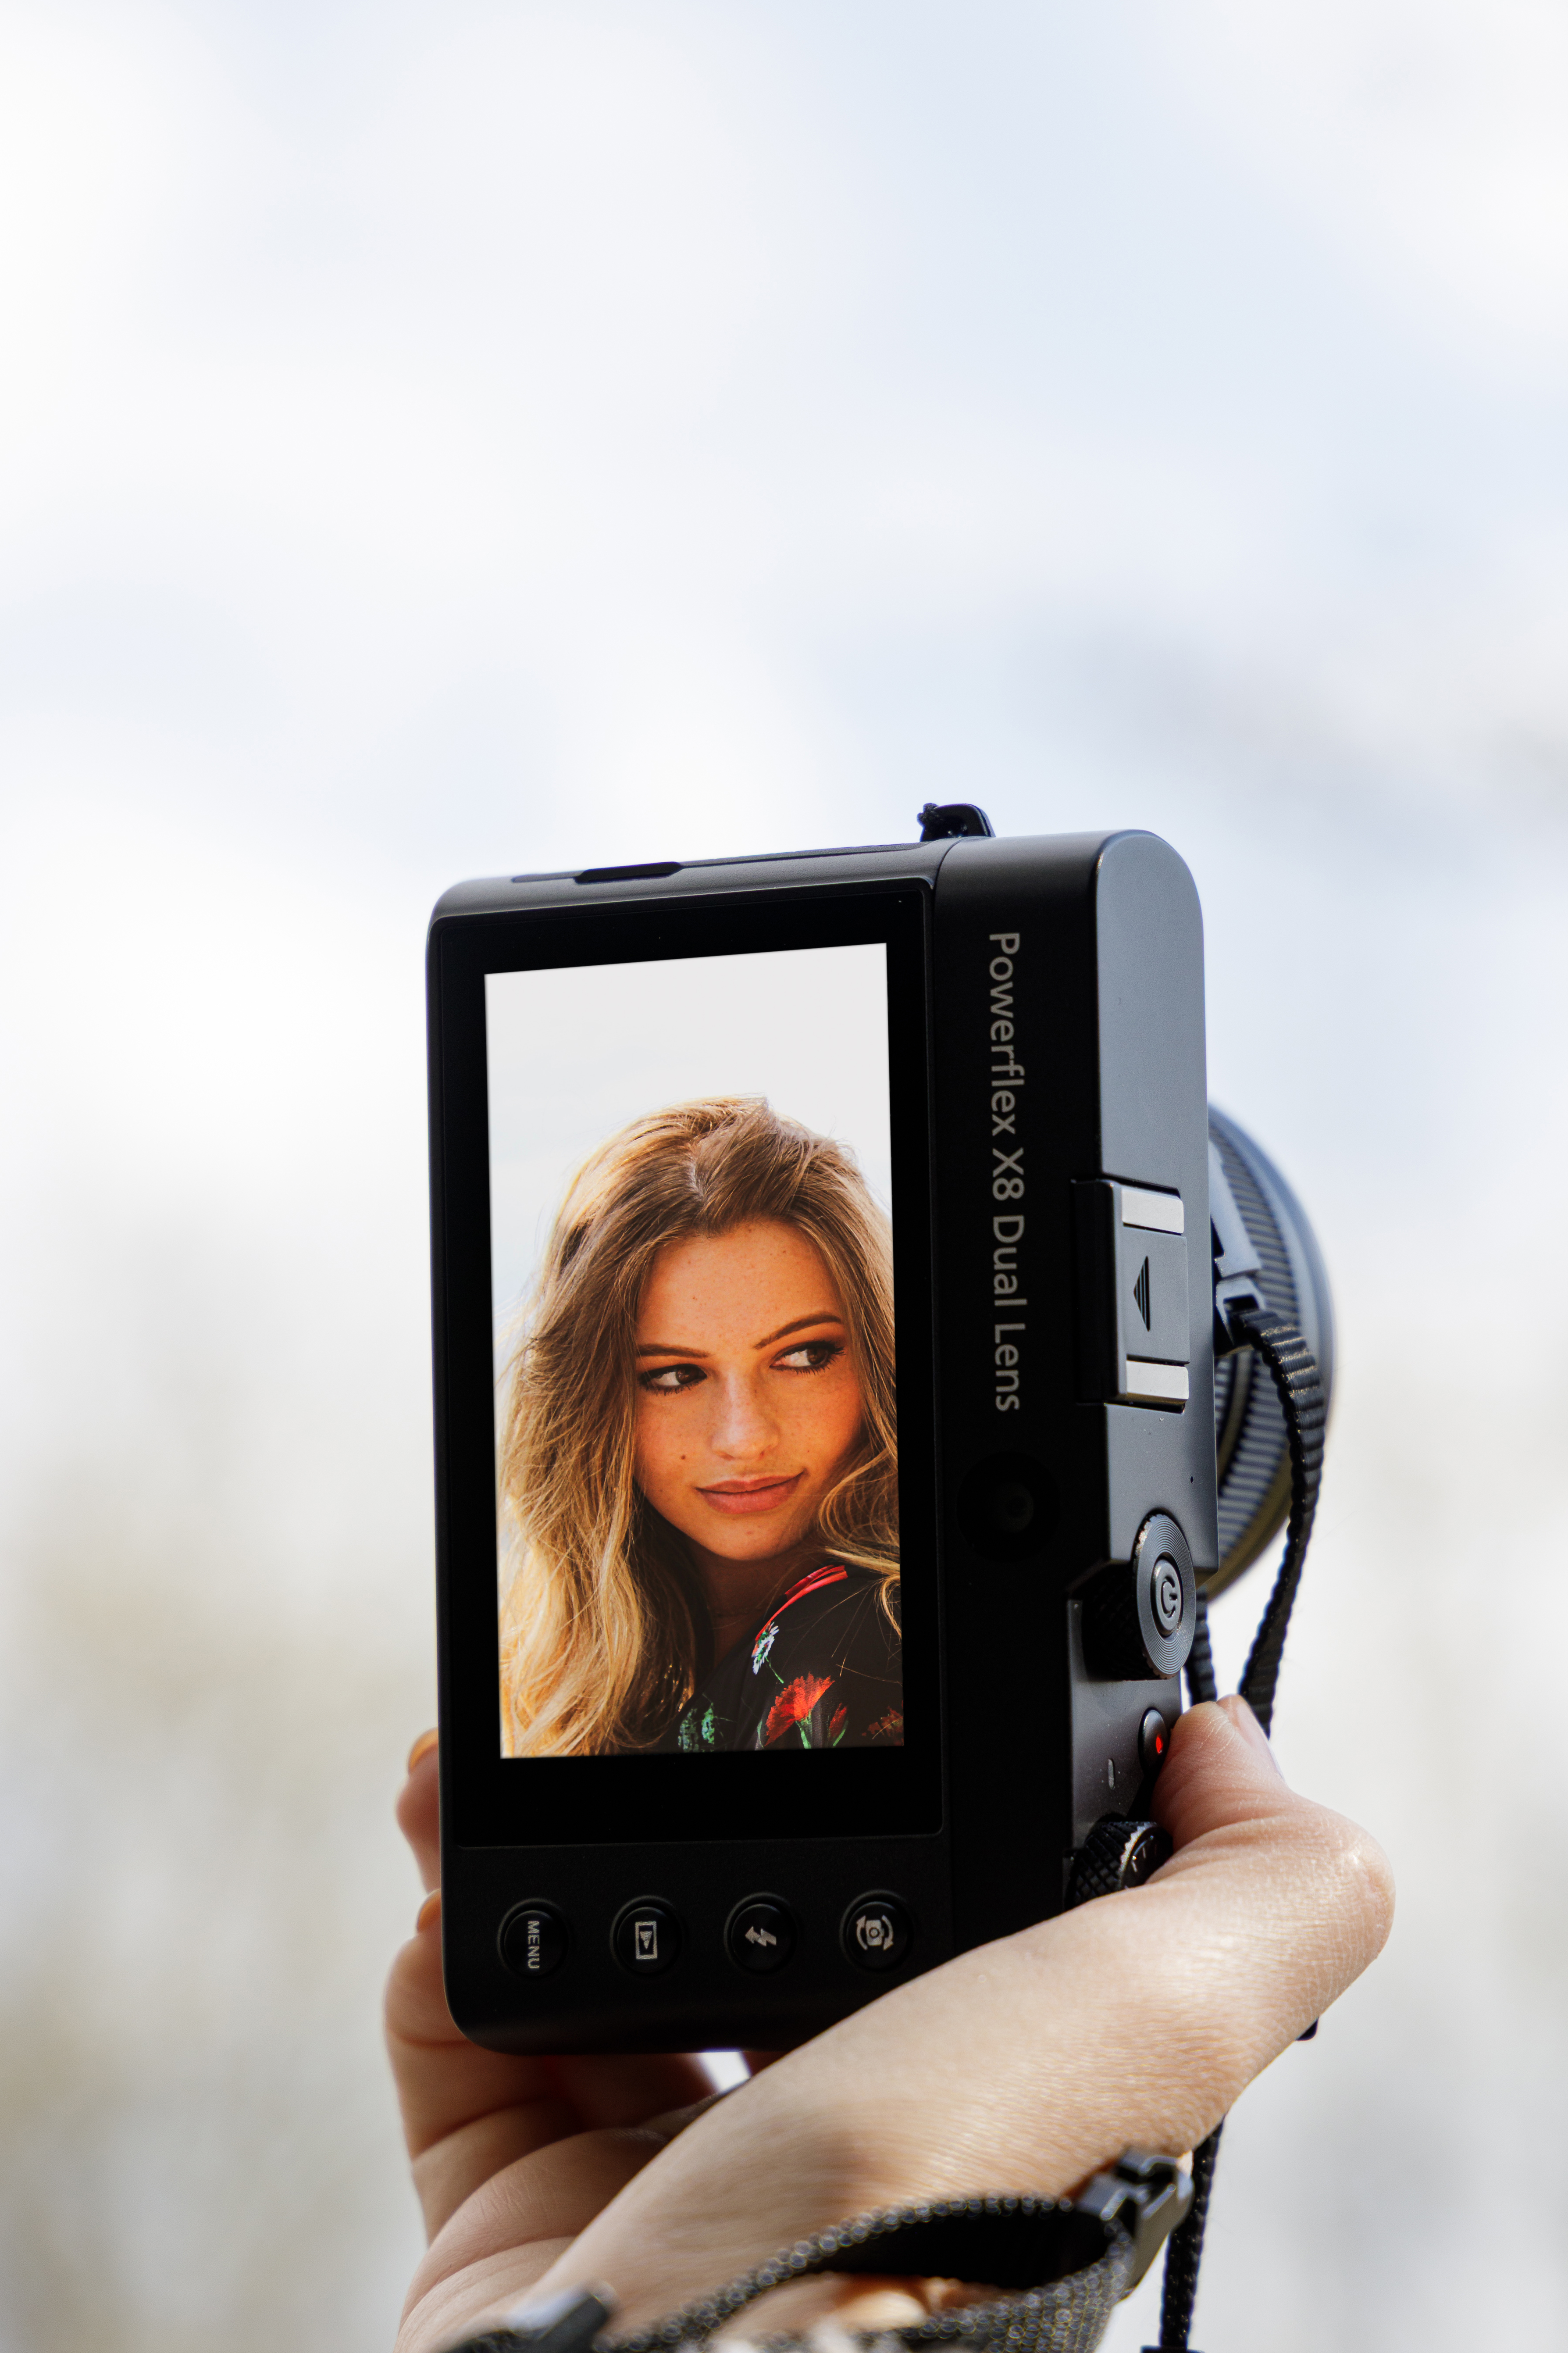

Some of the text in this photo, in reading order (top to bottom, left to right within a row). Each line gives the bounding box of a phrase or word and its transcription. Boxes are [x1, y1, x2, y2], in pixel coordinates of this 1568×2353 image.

[989, 933, 1027, 1411] Powerflex X8 Dual Lens
[527, 1920, 540, 1969] MENU
